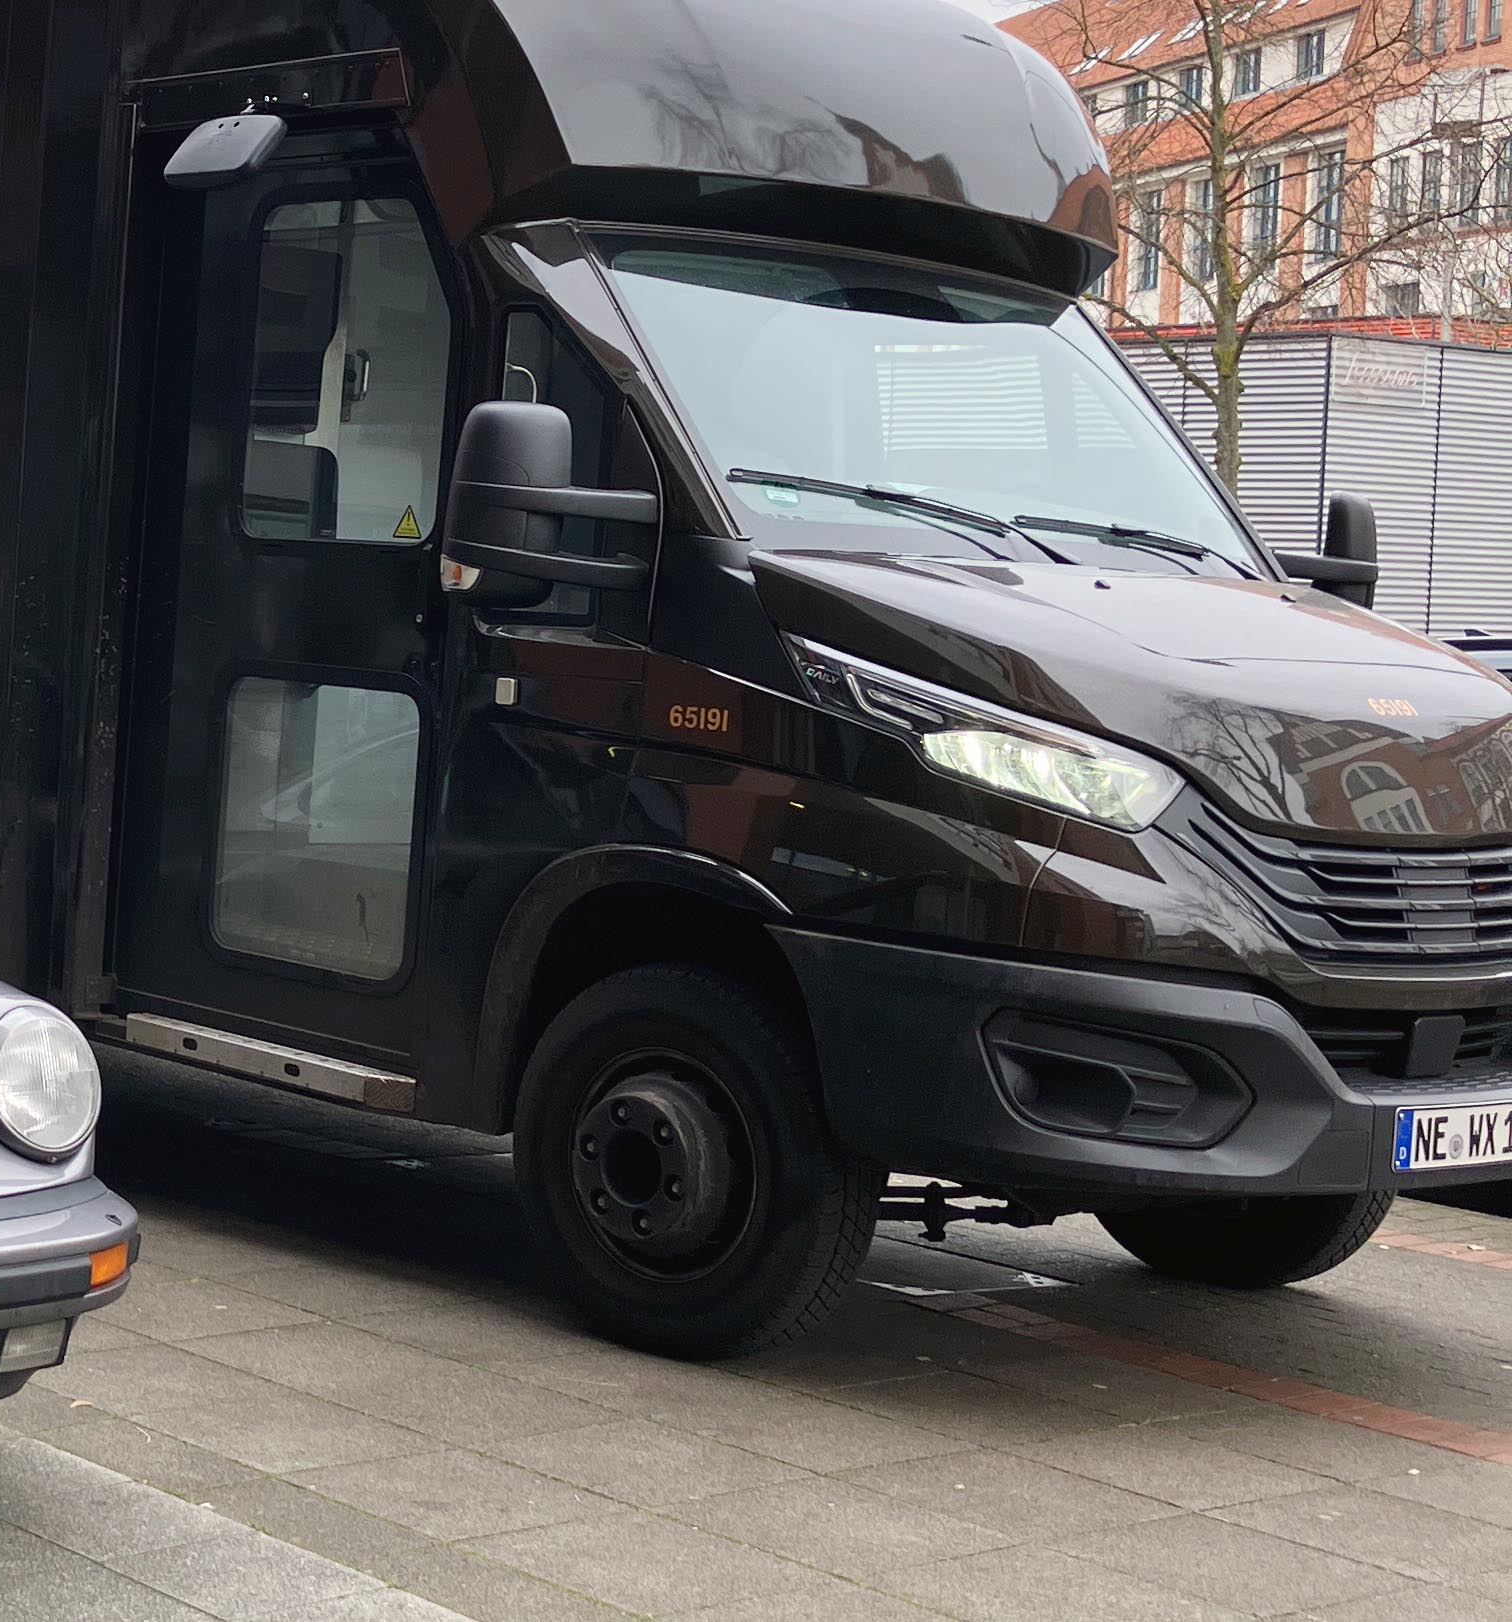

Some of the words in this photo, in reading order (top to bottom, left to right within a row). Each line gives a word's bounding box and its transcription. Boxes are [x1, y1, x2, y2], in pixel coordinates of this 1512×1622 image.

[669, 704, 729, 732] 65191
[1399, 1147, 1407, 1160] D
[1414, 1116, 1449, 1162] NE
[1468, 1112, 1498, 1157] WX
